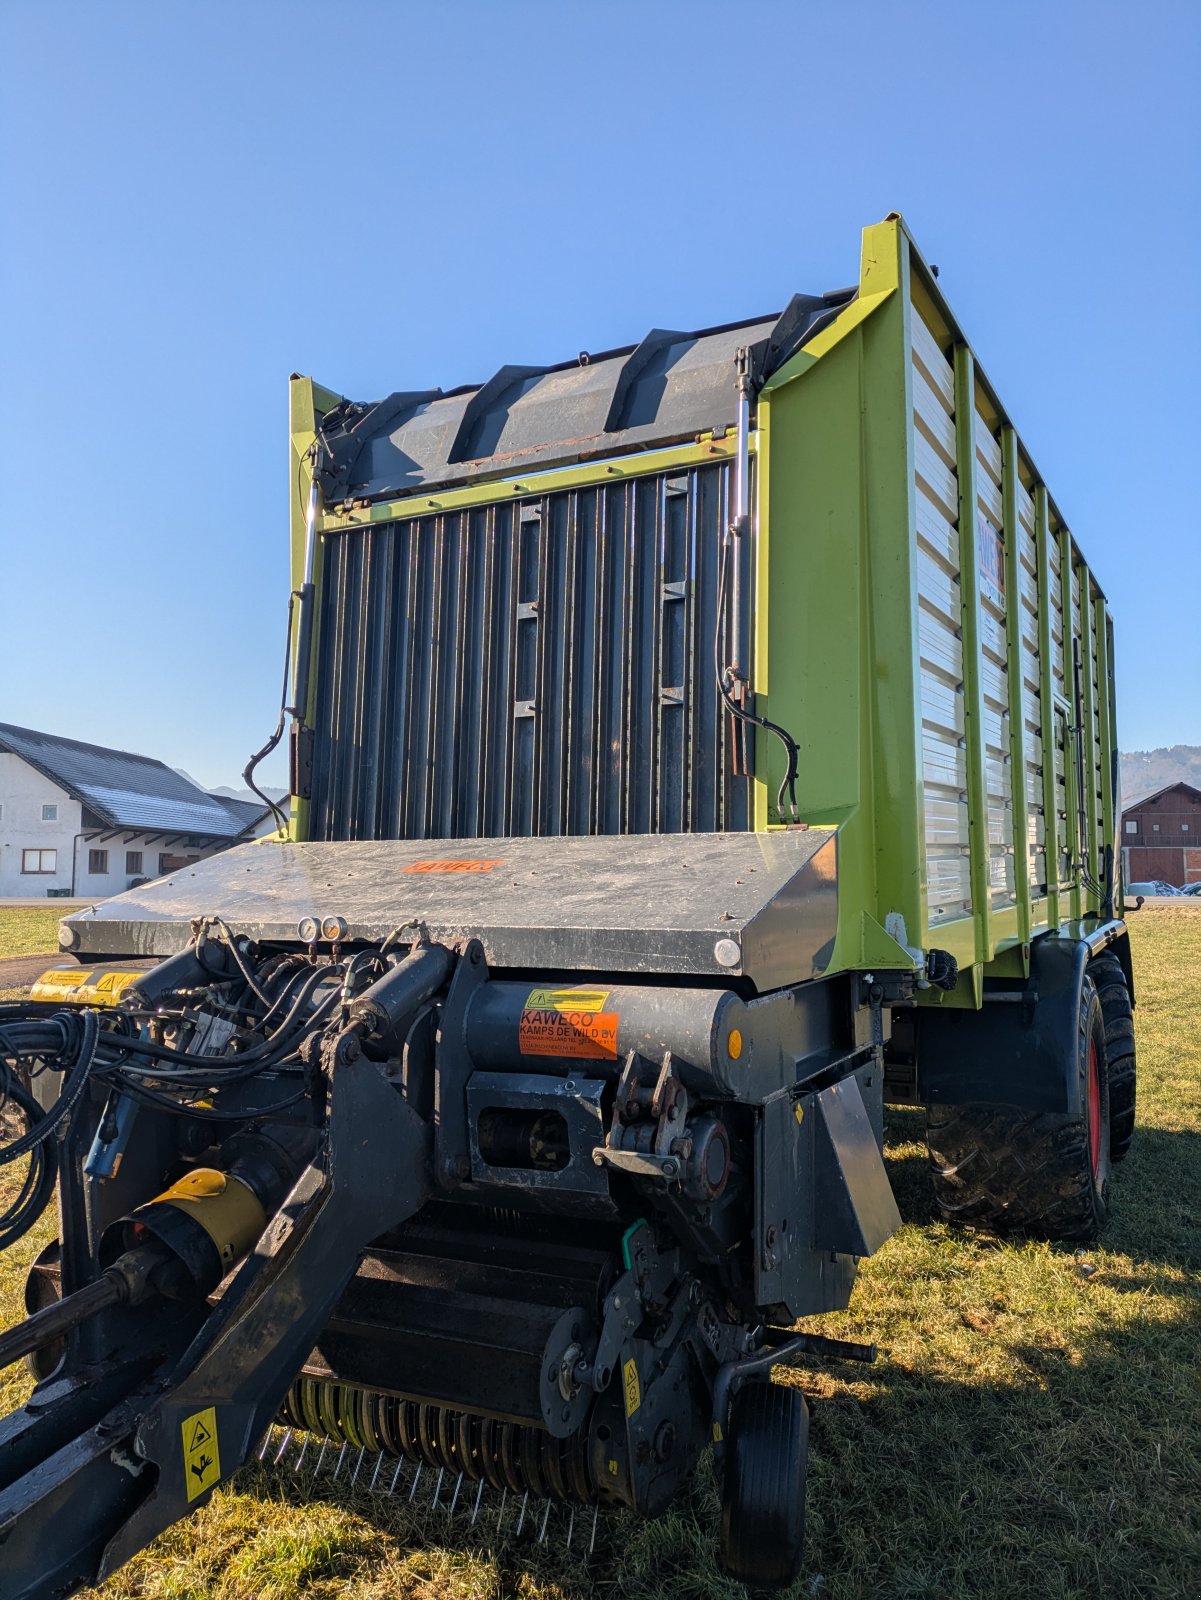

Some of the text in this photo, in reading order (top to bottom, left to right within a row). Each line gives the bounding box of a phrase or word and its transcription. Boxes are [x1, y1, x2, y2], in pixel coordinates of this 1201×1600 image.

[521, 1010, 593, 1027] KAWECO
[520, 1025, 554, 1036] KAMPS
[557, 1027, 570, 1036] DE
[573, 1028, 599, 1038] WILD
